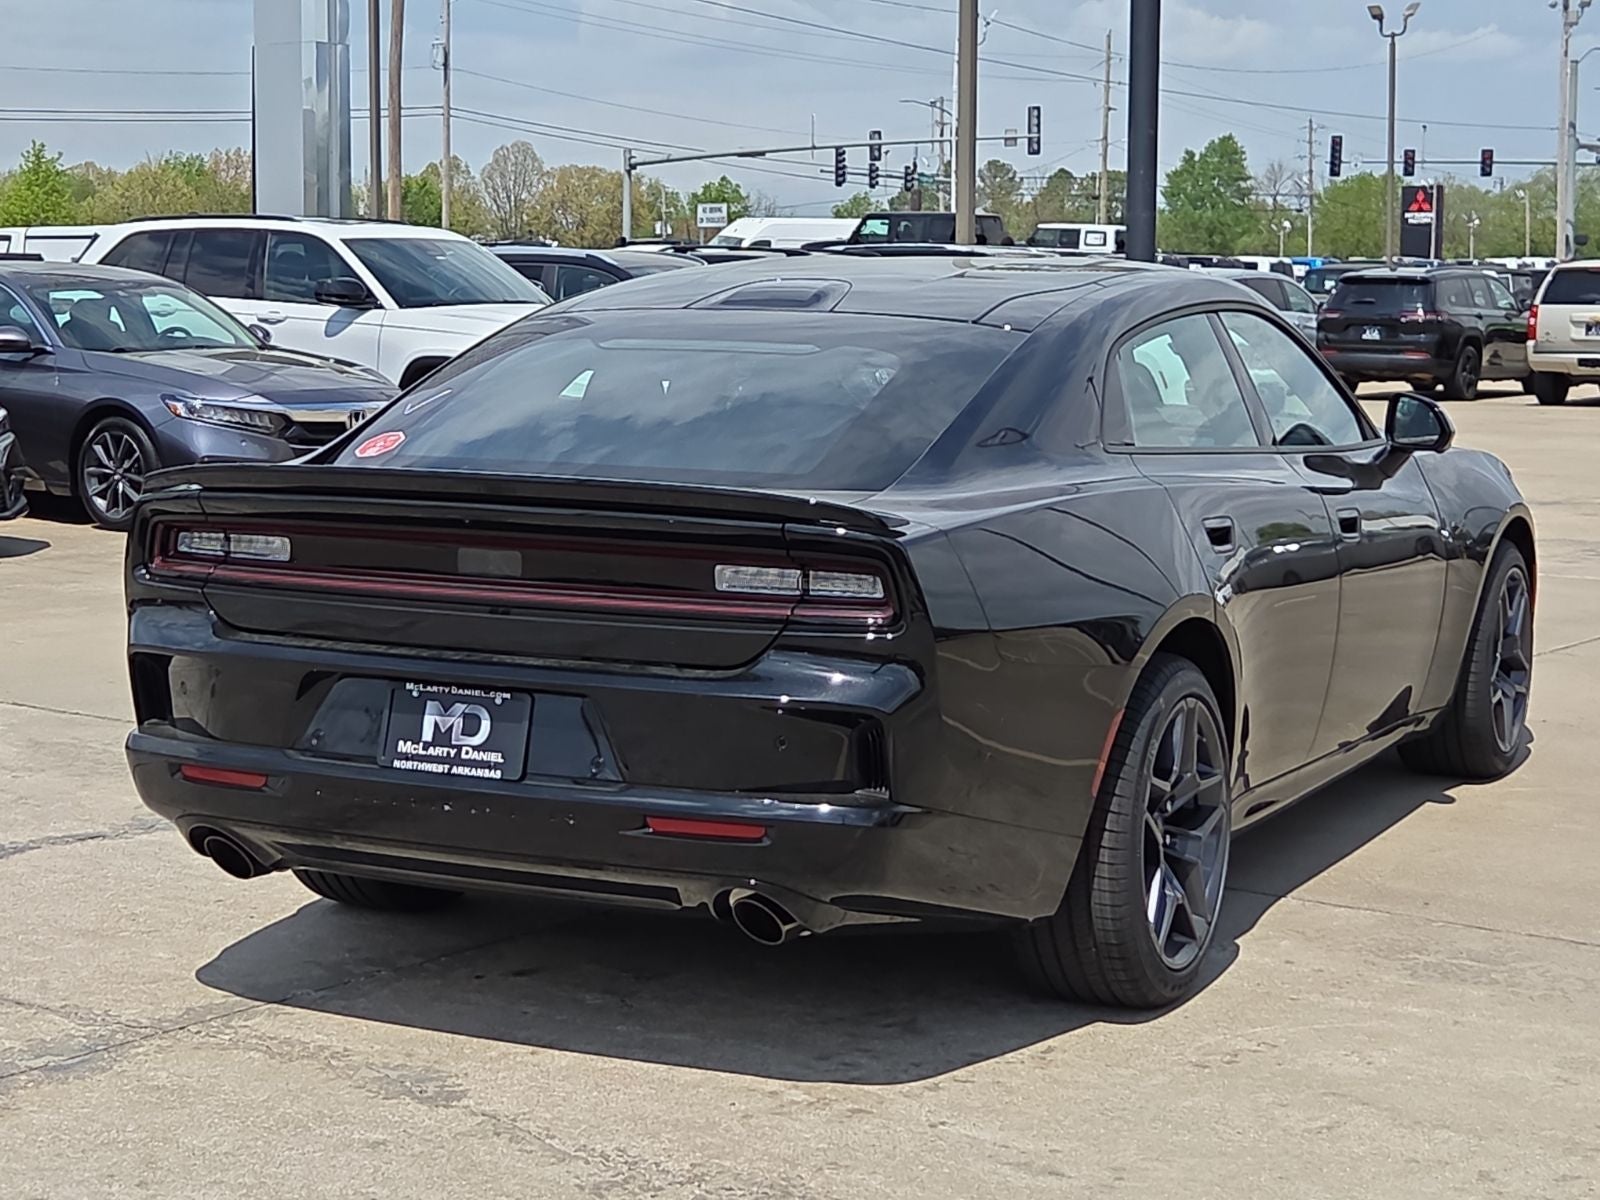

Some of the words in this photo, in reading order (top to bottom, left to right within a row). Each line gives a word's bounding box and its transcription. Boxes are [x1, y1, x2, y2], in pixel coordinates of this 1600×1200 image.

[421, 699, 491, 746] MD
[461, 746, 504, 763] DANIEL
[393, 759, 449, 773] NORTHWEST
[451, 765, 501, 778] ARKANSAS
